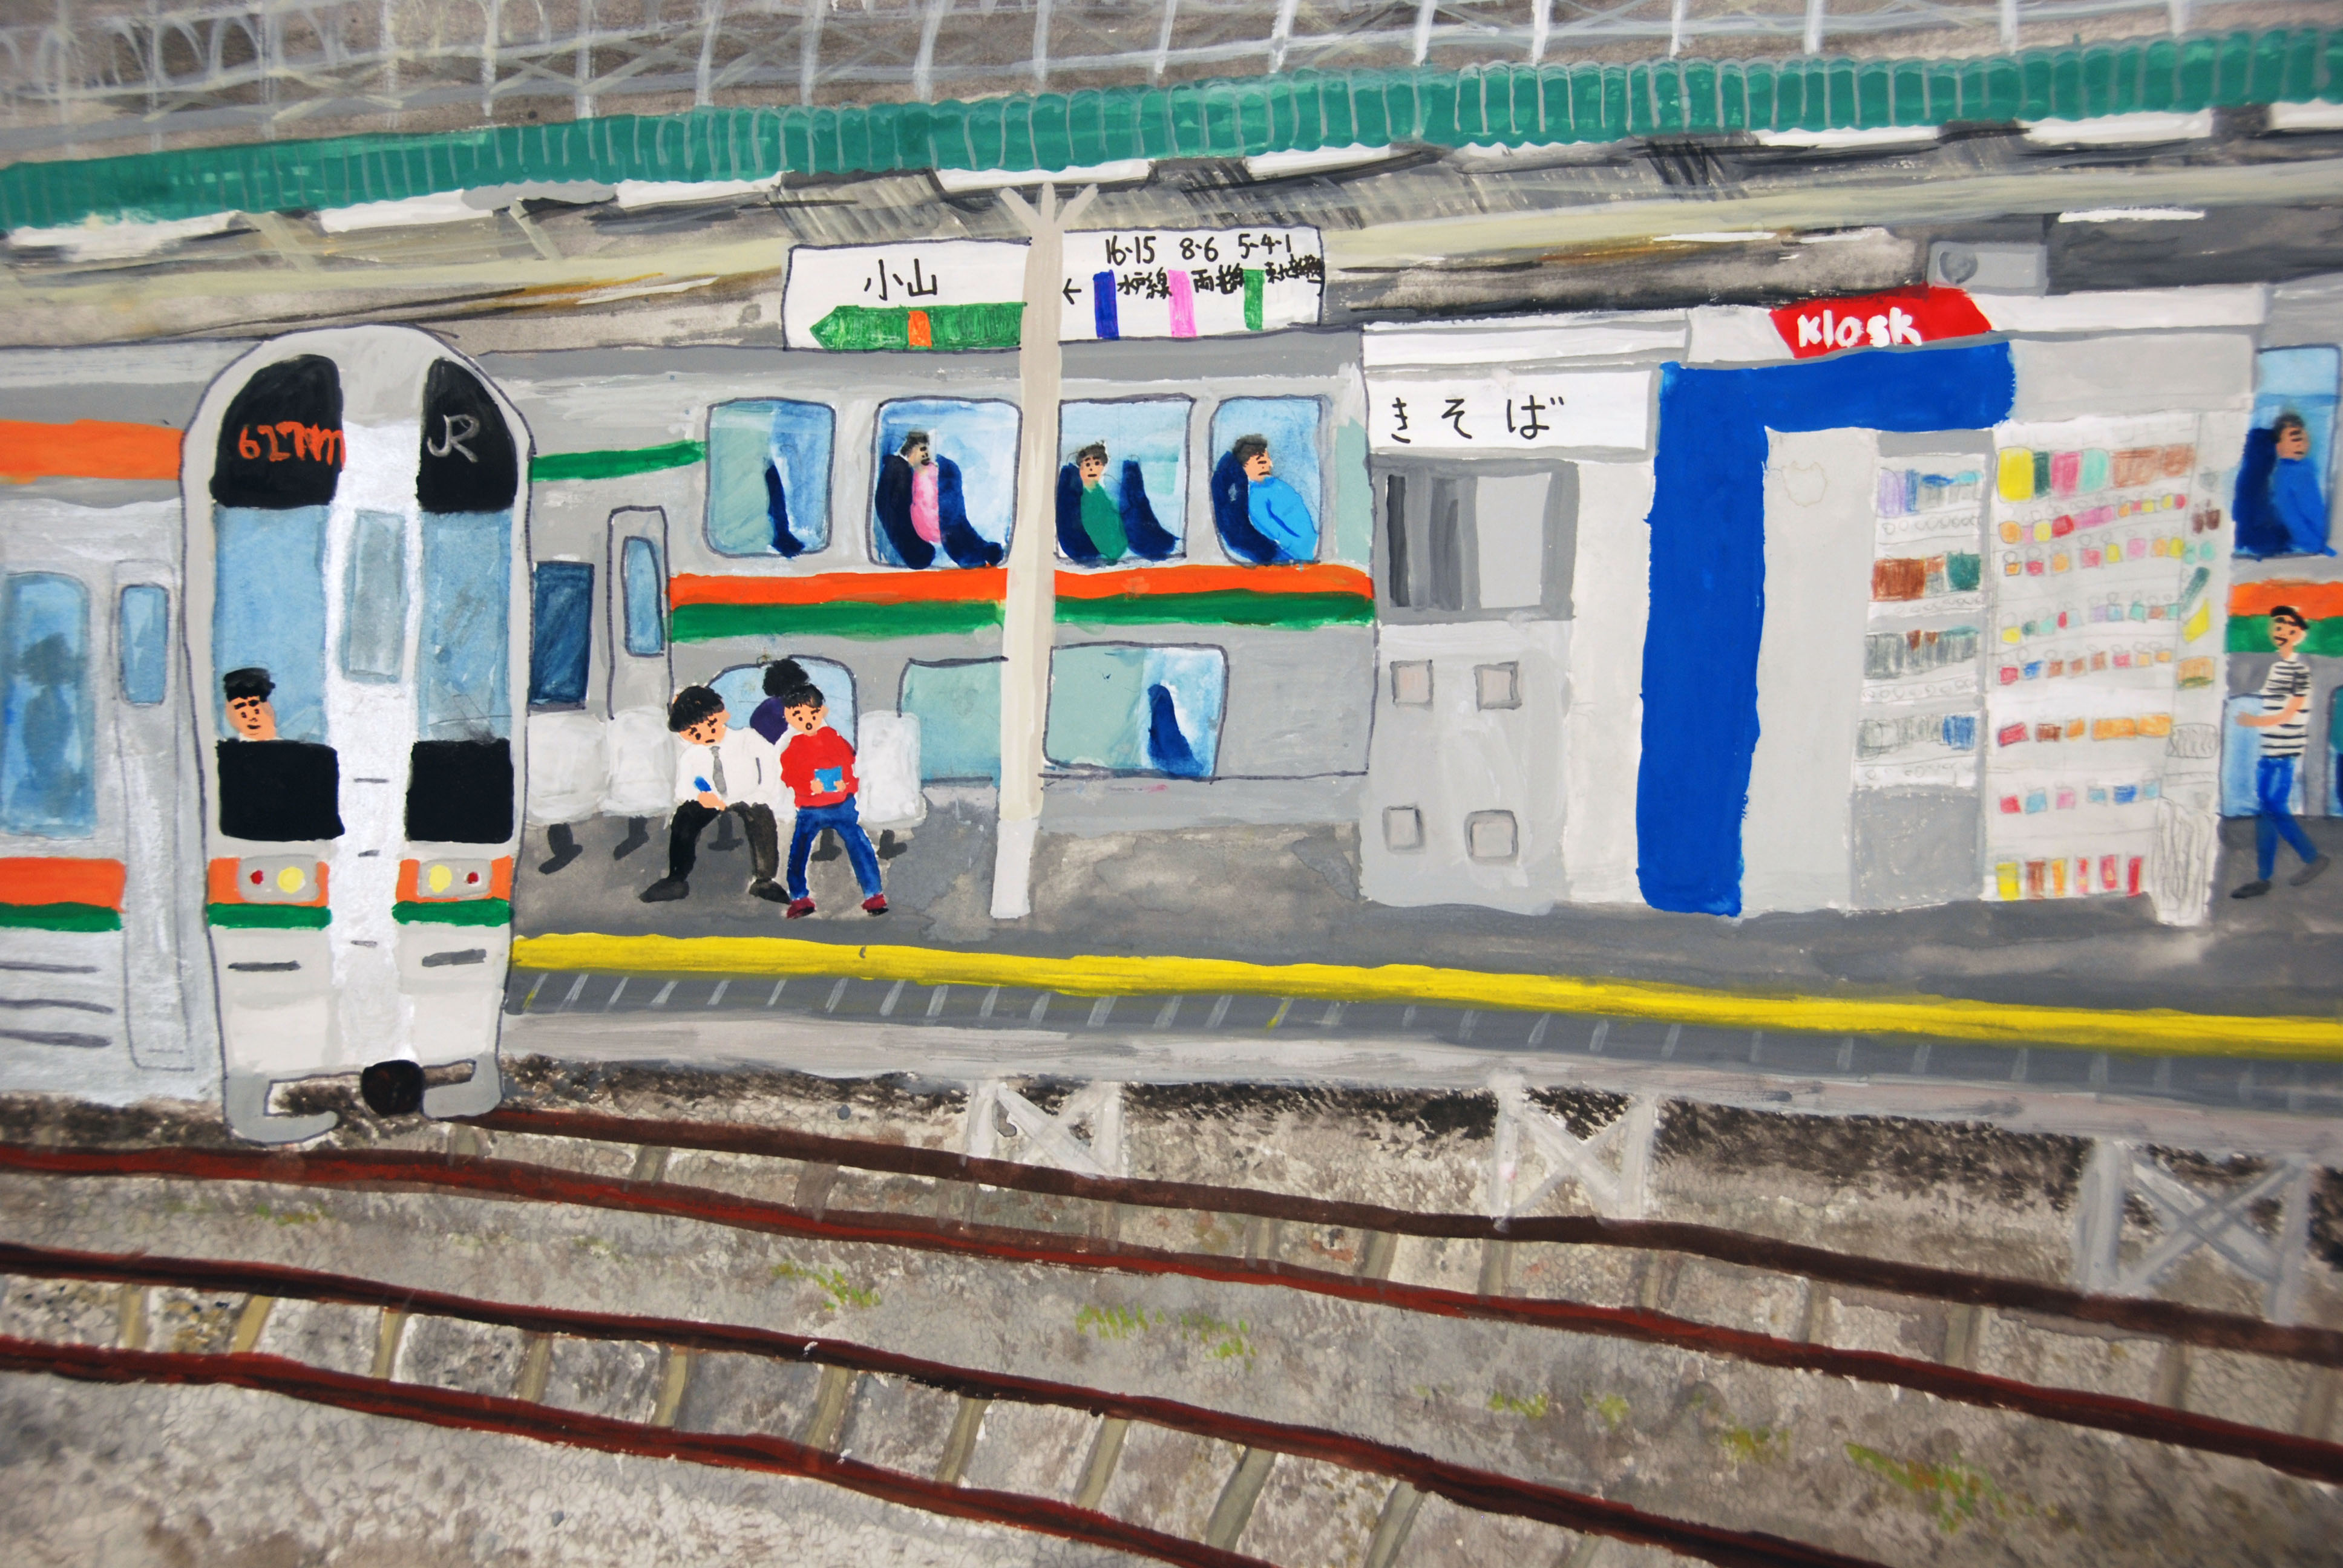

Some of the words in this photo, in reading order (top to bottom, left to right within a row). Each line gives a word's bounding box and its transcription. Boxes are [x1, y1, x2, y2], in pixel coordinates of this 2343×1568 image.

[864, 258, 937, 301] 小山
[427, 414, 479, 462] JR
[1391, 394, 1564, 443] きそば
